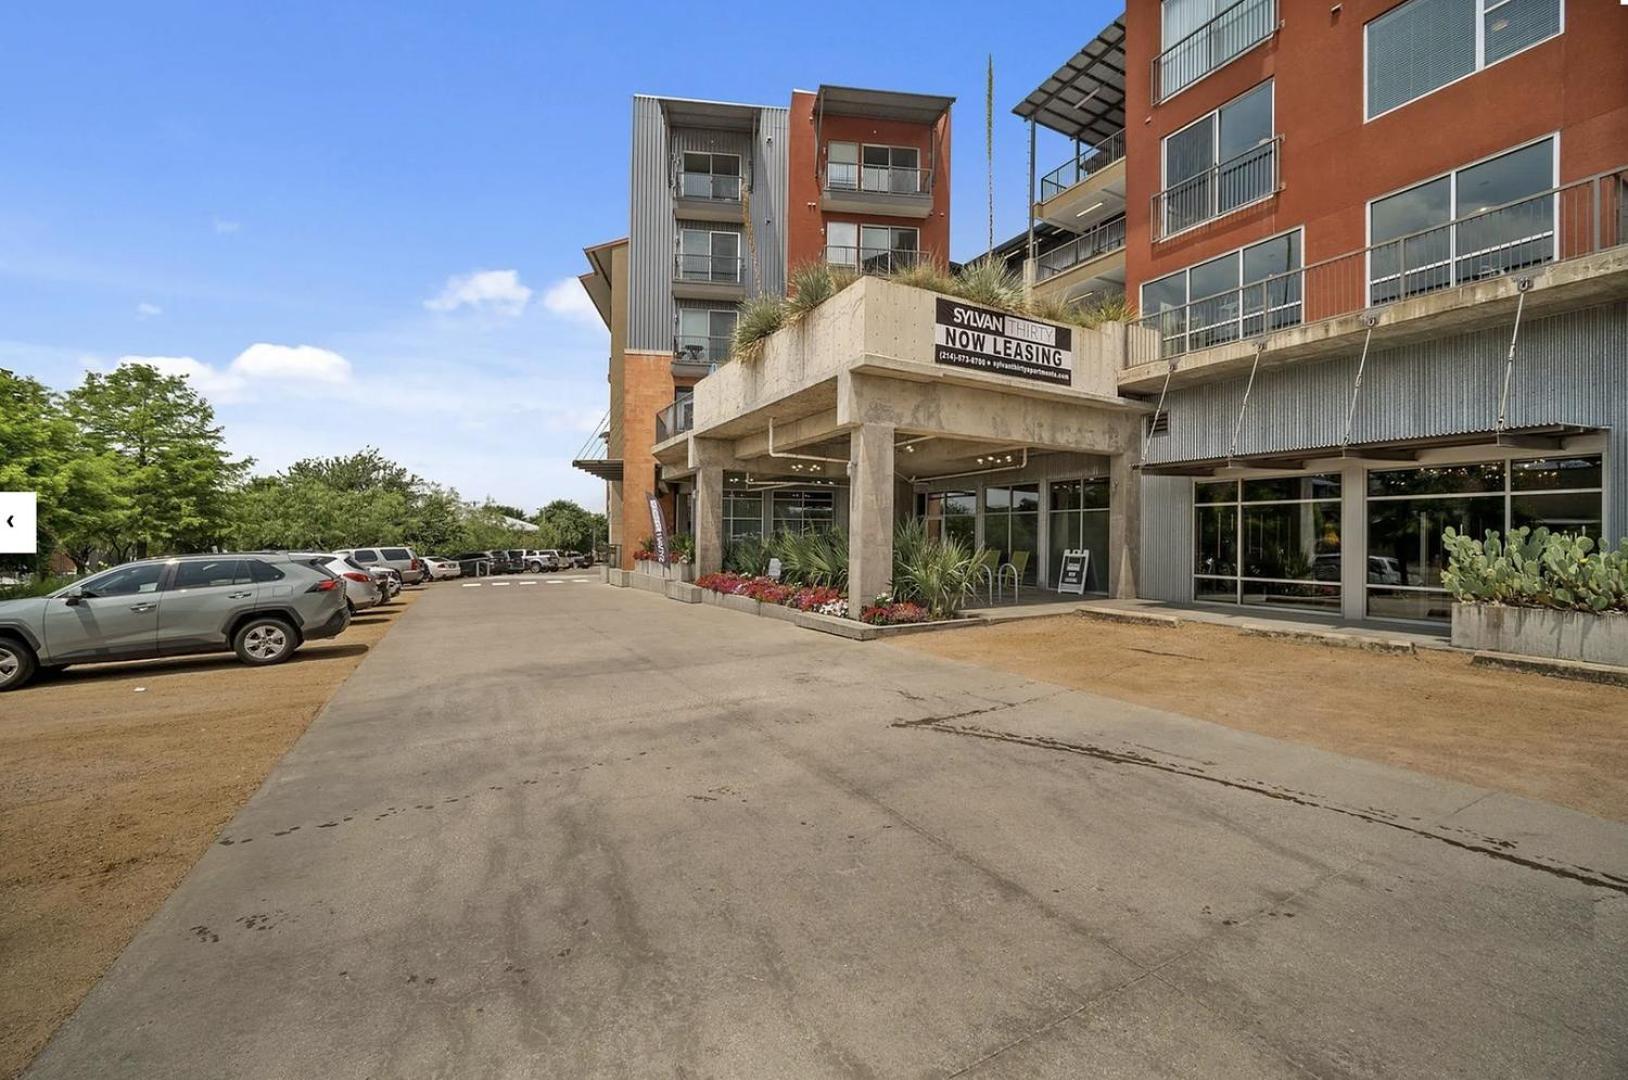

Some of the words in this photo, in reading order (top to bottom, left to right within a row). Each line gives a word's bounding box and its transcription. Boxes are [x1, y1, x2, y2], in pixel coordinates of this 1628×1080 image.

[953, 307, 1004, 332] SYLVAN
[1009, 320, 1054, 341] THIRTY
[945, 327, 985, 351] NOW
[993, 338, 1063, 366] LEASING
